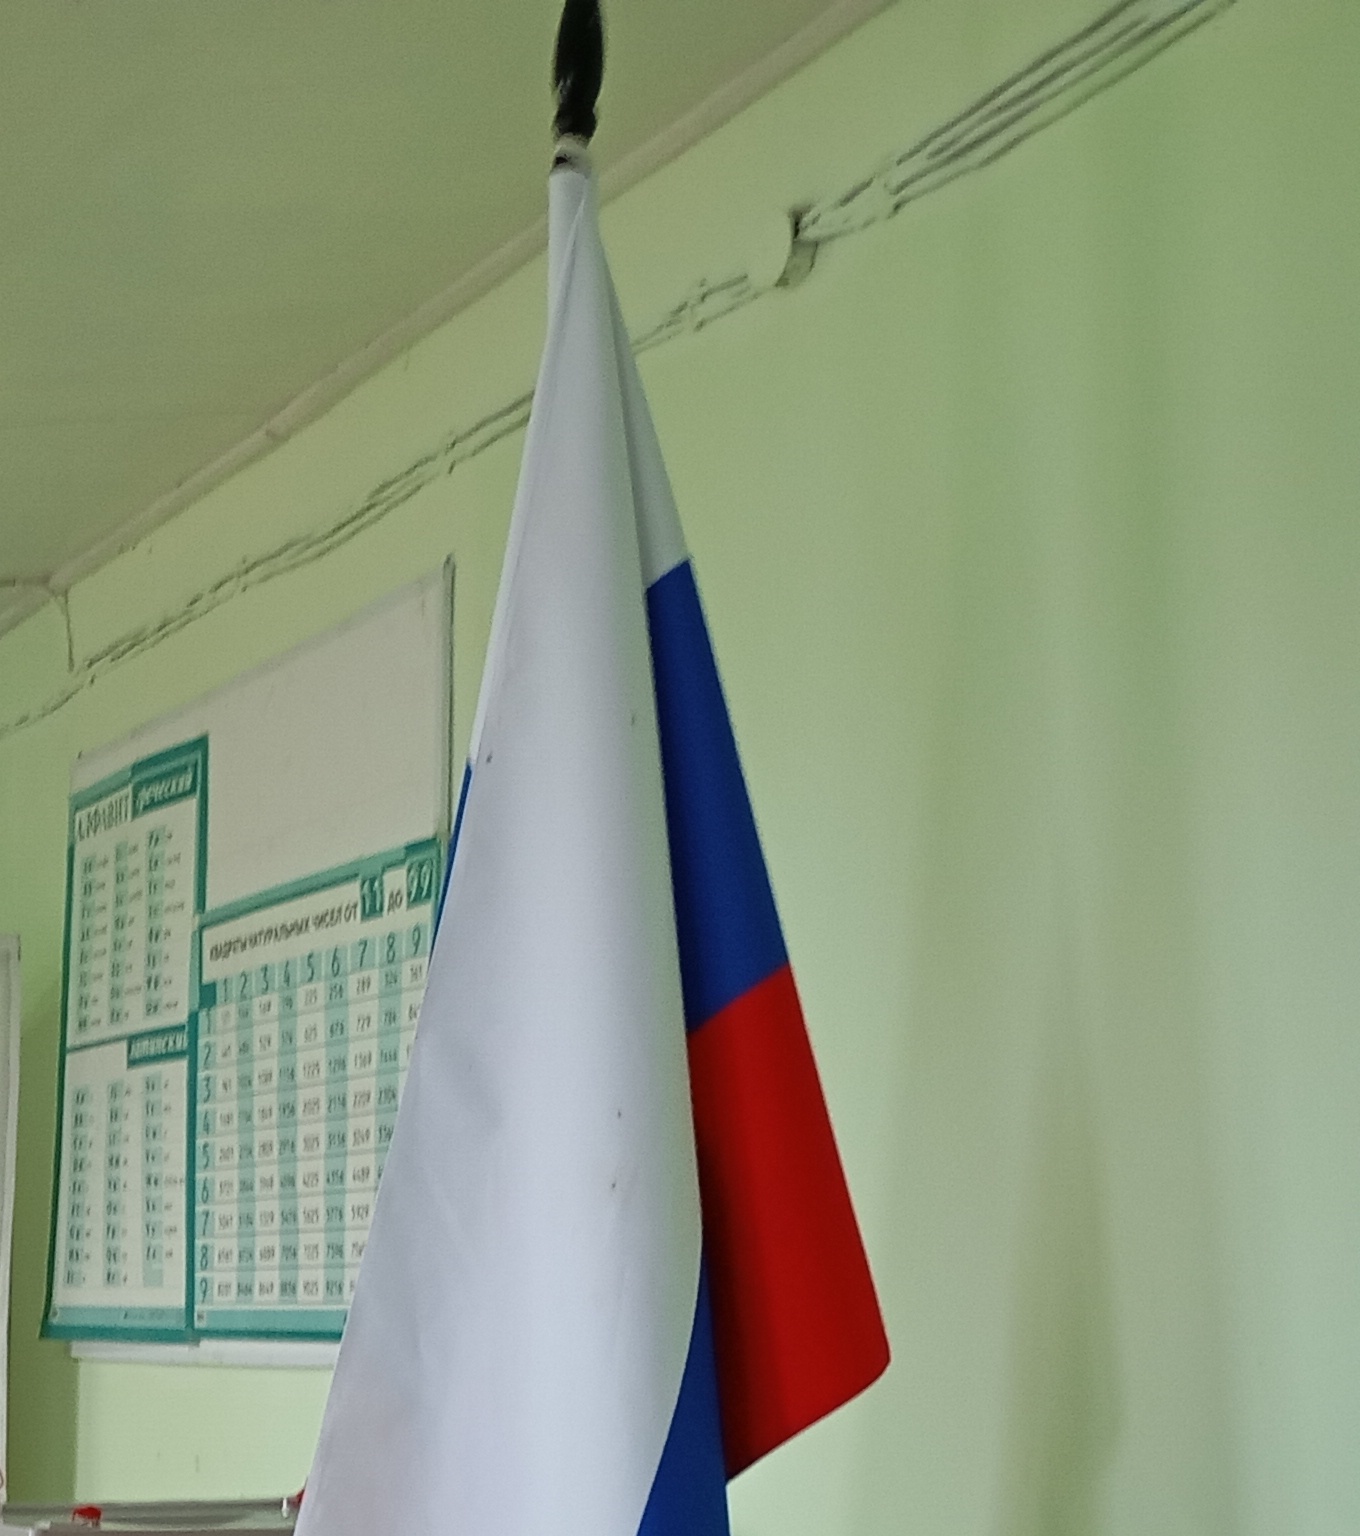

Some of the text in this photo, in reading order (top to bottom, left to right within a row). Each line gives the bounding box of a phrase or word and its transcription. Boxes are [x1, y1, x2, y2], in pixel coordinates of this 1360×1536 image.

[362, 877, 382, 915] 11
[387, 889, 403, 915] ДО
[406, 858, 430, 902] 99
[223, 922, 421, 1002] 1 2 3 4 5 6 7 8 9
[203, 1041, 211, 1070] 2
[203, 1075, 211, 1103] 3
[203, 1110, 210, 1135] 4
[202, 1142, 210, 1170] 5
[201, 1176, 209, 1203] 6
[202, 1209, 210, 1236] 7
[200, 1243, 208, 1271] 8
[200, 1277, 208, 1304] 9
